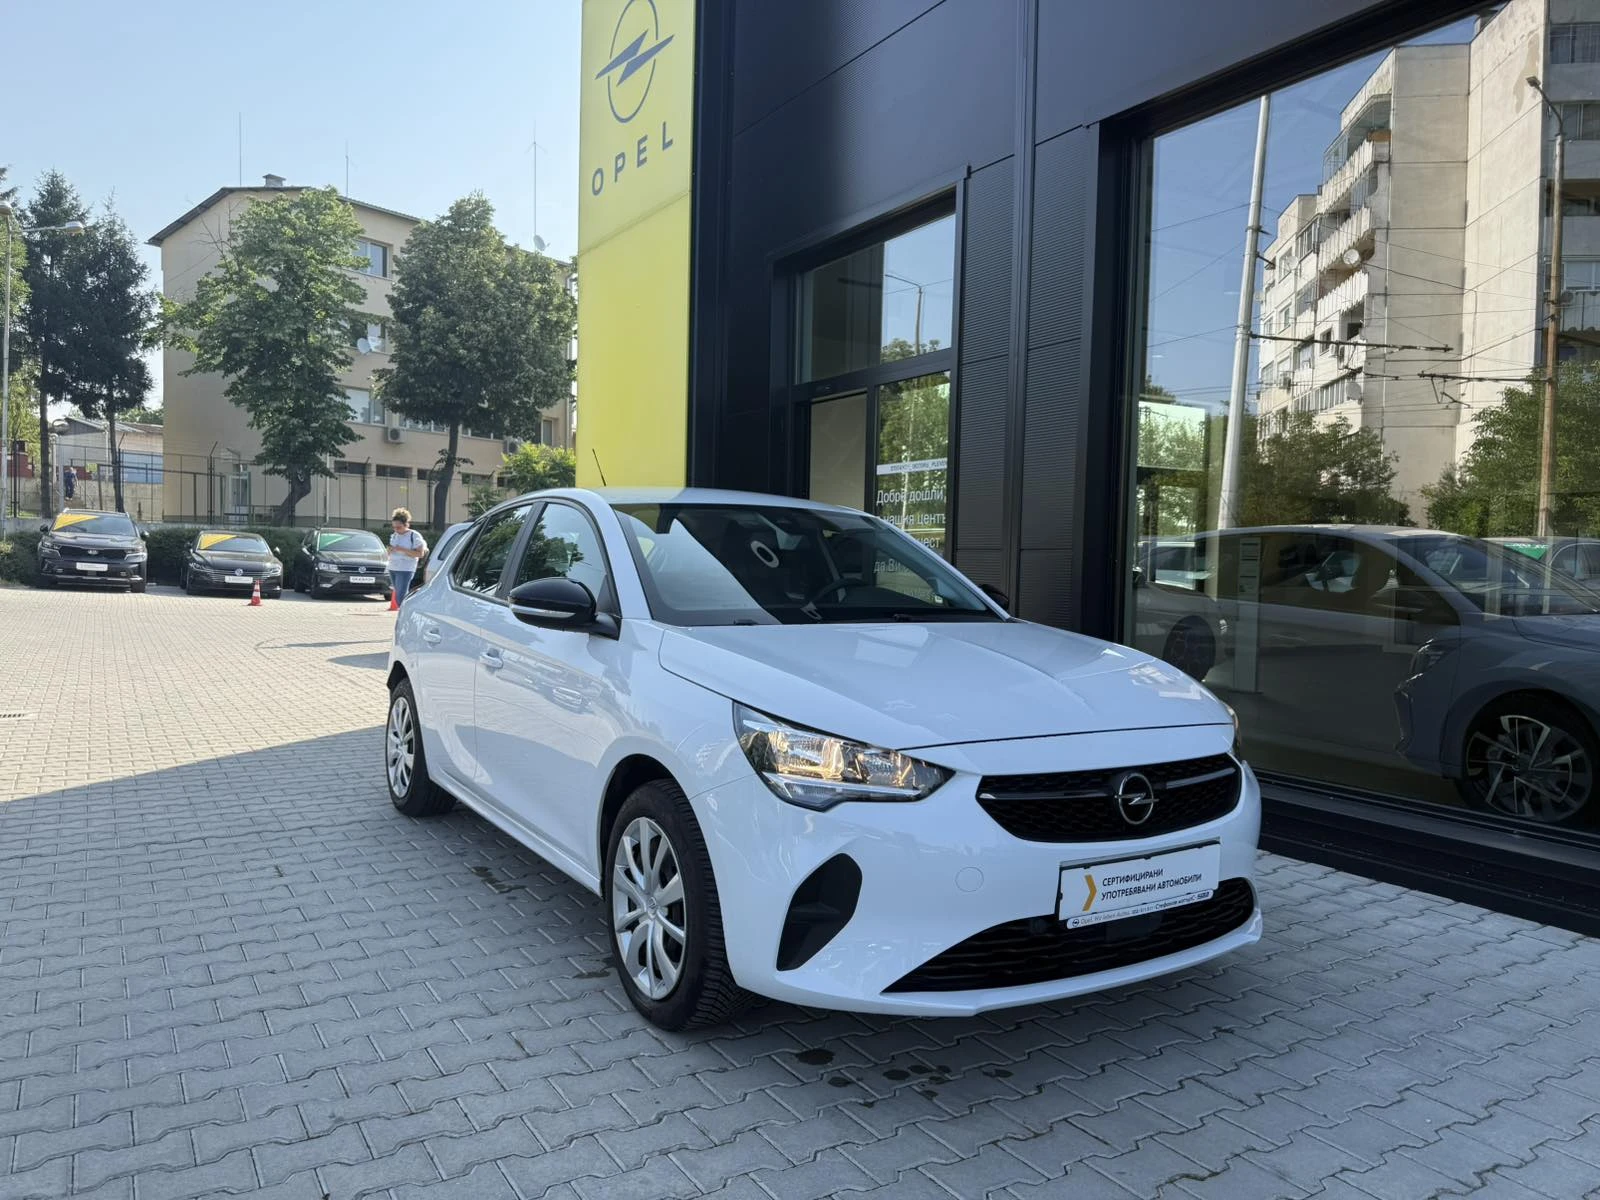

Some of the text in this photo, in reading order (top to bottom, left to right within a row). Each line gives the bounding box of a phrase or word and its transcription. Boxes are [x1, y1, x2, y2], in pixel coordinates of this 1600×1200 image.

[592, 121, 673, 196] OPEL
[876, 489, 906, 506] Добре
[1101, 873, 1202, 901] УПОТРЕБЯВАНИ АВТОМОБИЛИ
[1102, 868, 1164, 886] СЕРТИФИЦИРАНИ
